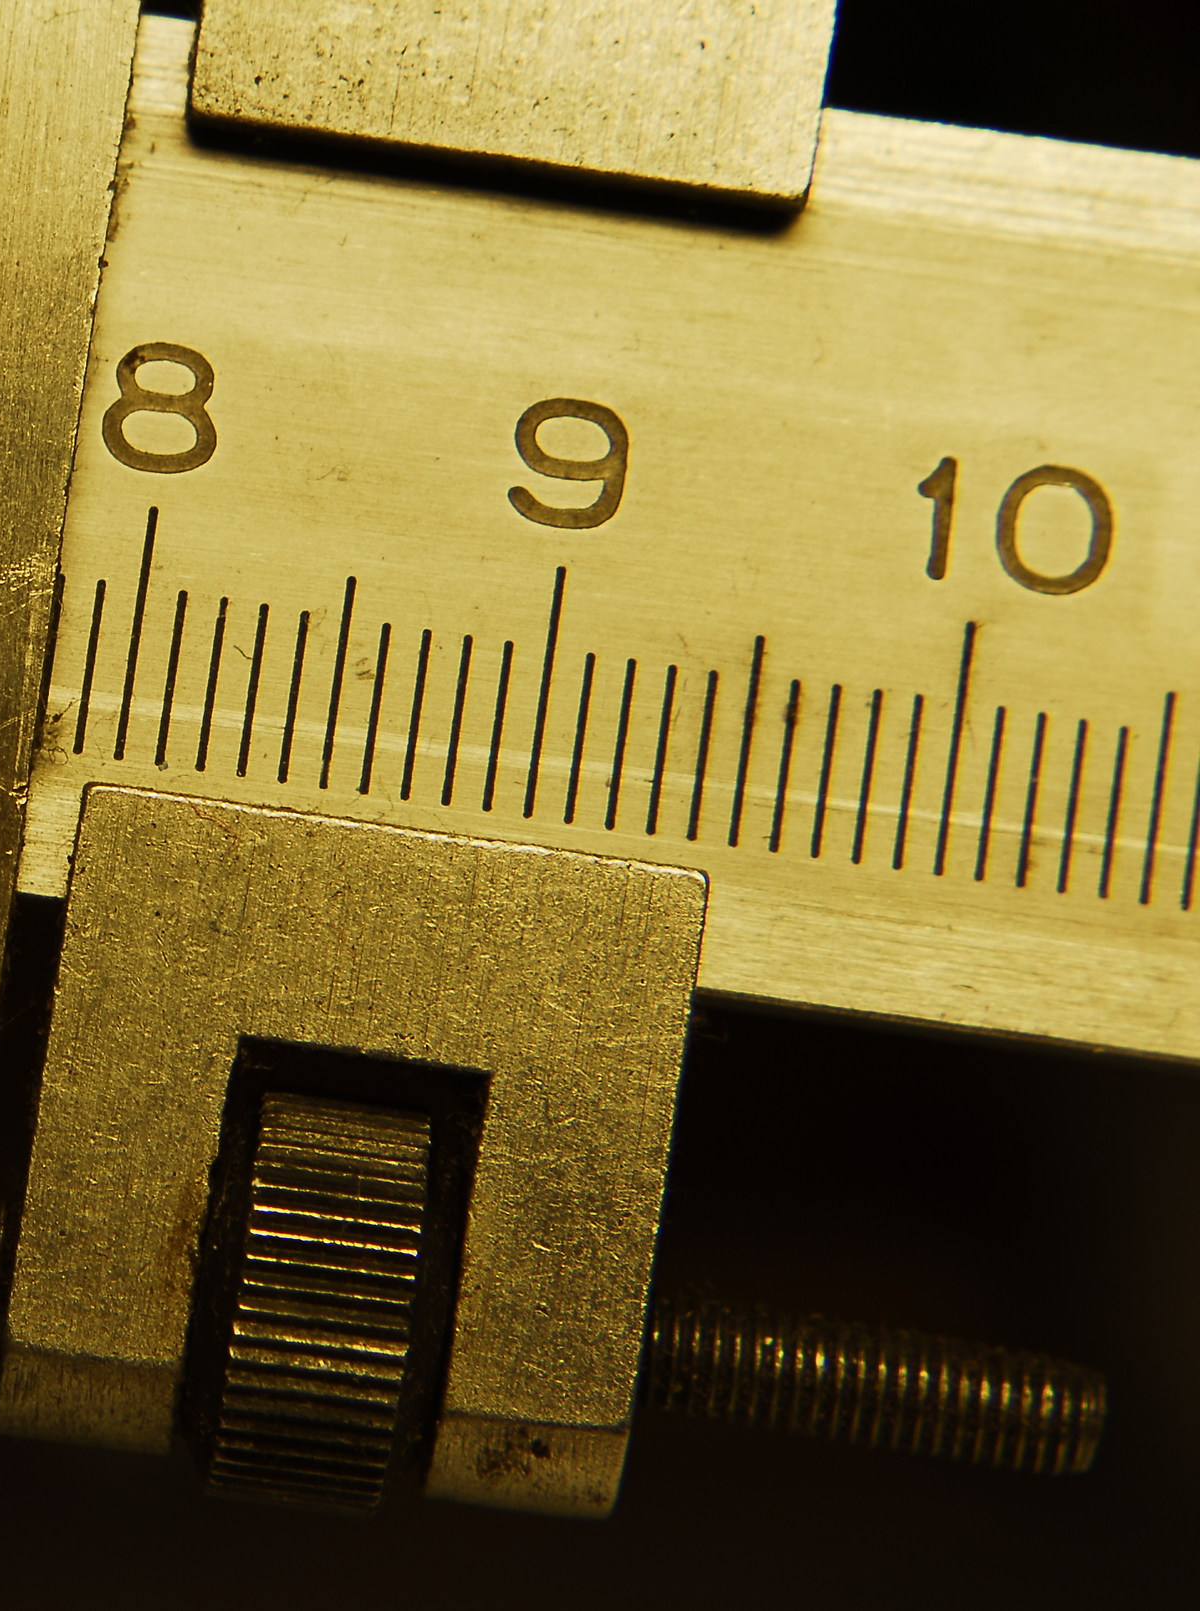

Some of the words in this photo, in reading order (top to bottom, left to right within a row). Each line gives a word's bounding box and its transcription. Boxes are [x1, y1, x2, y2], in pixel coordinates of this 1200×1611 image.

[102, 341, 217, 474] 8
[507, 397, 629, 530] 9
[917, 456, 1114, 596] 10
